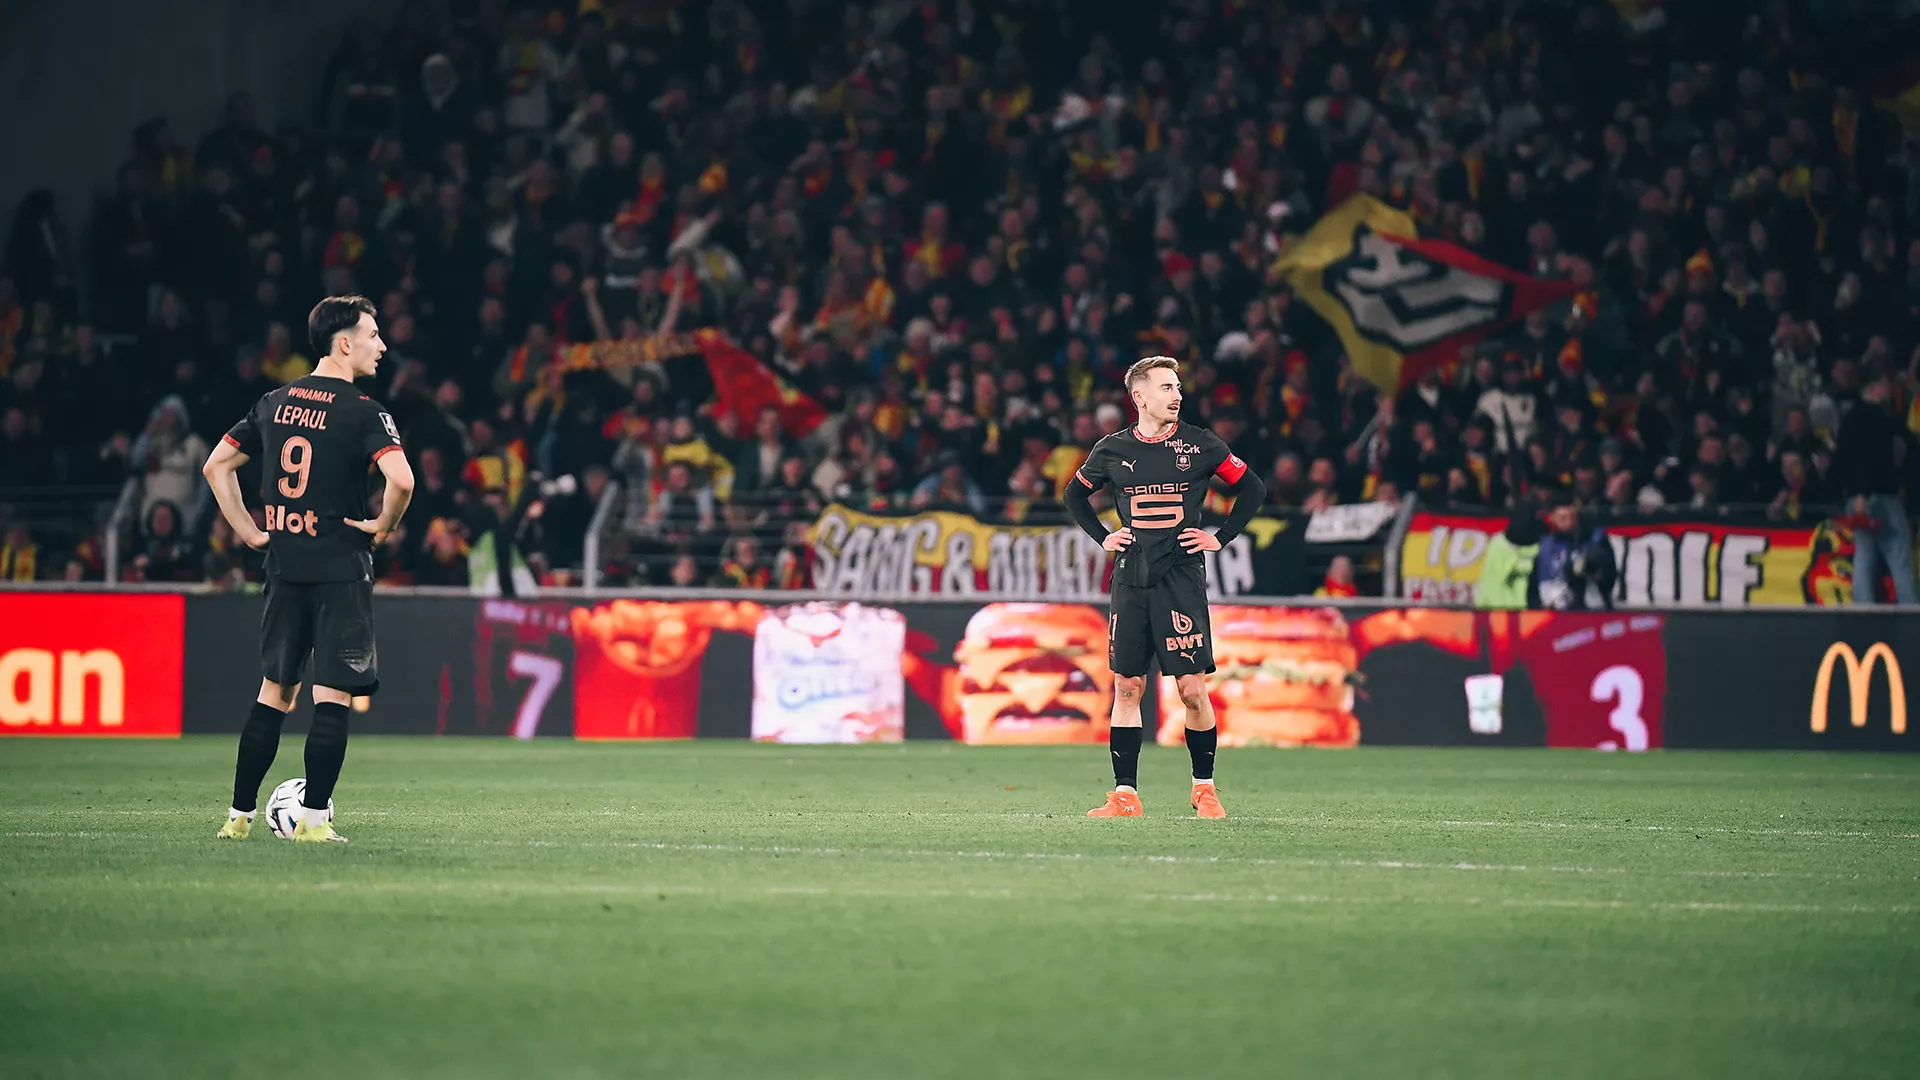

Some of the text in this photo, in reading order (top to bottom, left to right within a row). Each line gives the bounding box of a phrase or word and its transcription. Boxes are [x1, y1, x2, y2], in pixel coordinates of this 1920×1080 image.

[288, 386, 336, 403] WINAMAX
[273, 404, 327, 430] LEPAUL
[277, 435, 313, 499] 9
[1123, 482, 1189, 495] SAMSIC
[265, 505, 319, 537] Blot
[1165, 633, 1204, 652] BWT
[0, 648, 124, 726] an
[510, 652, 563, 738] 7
